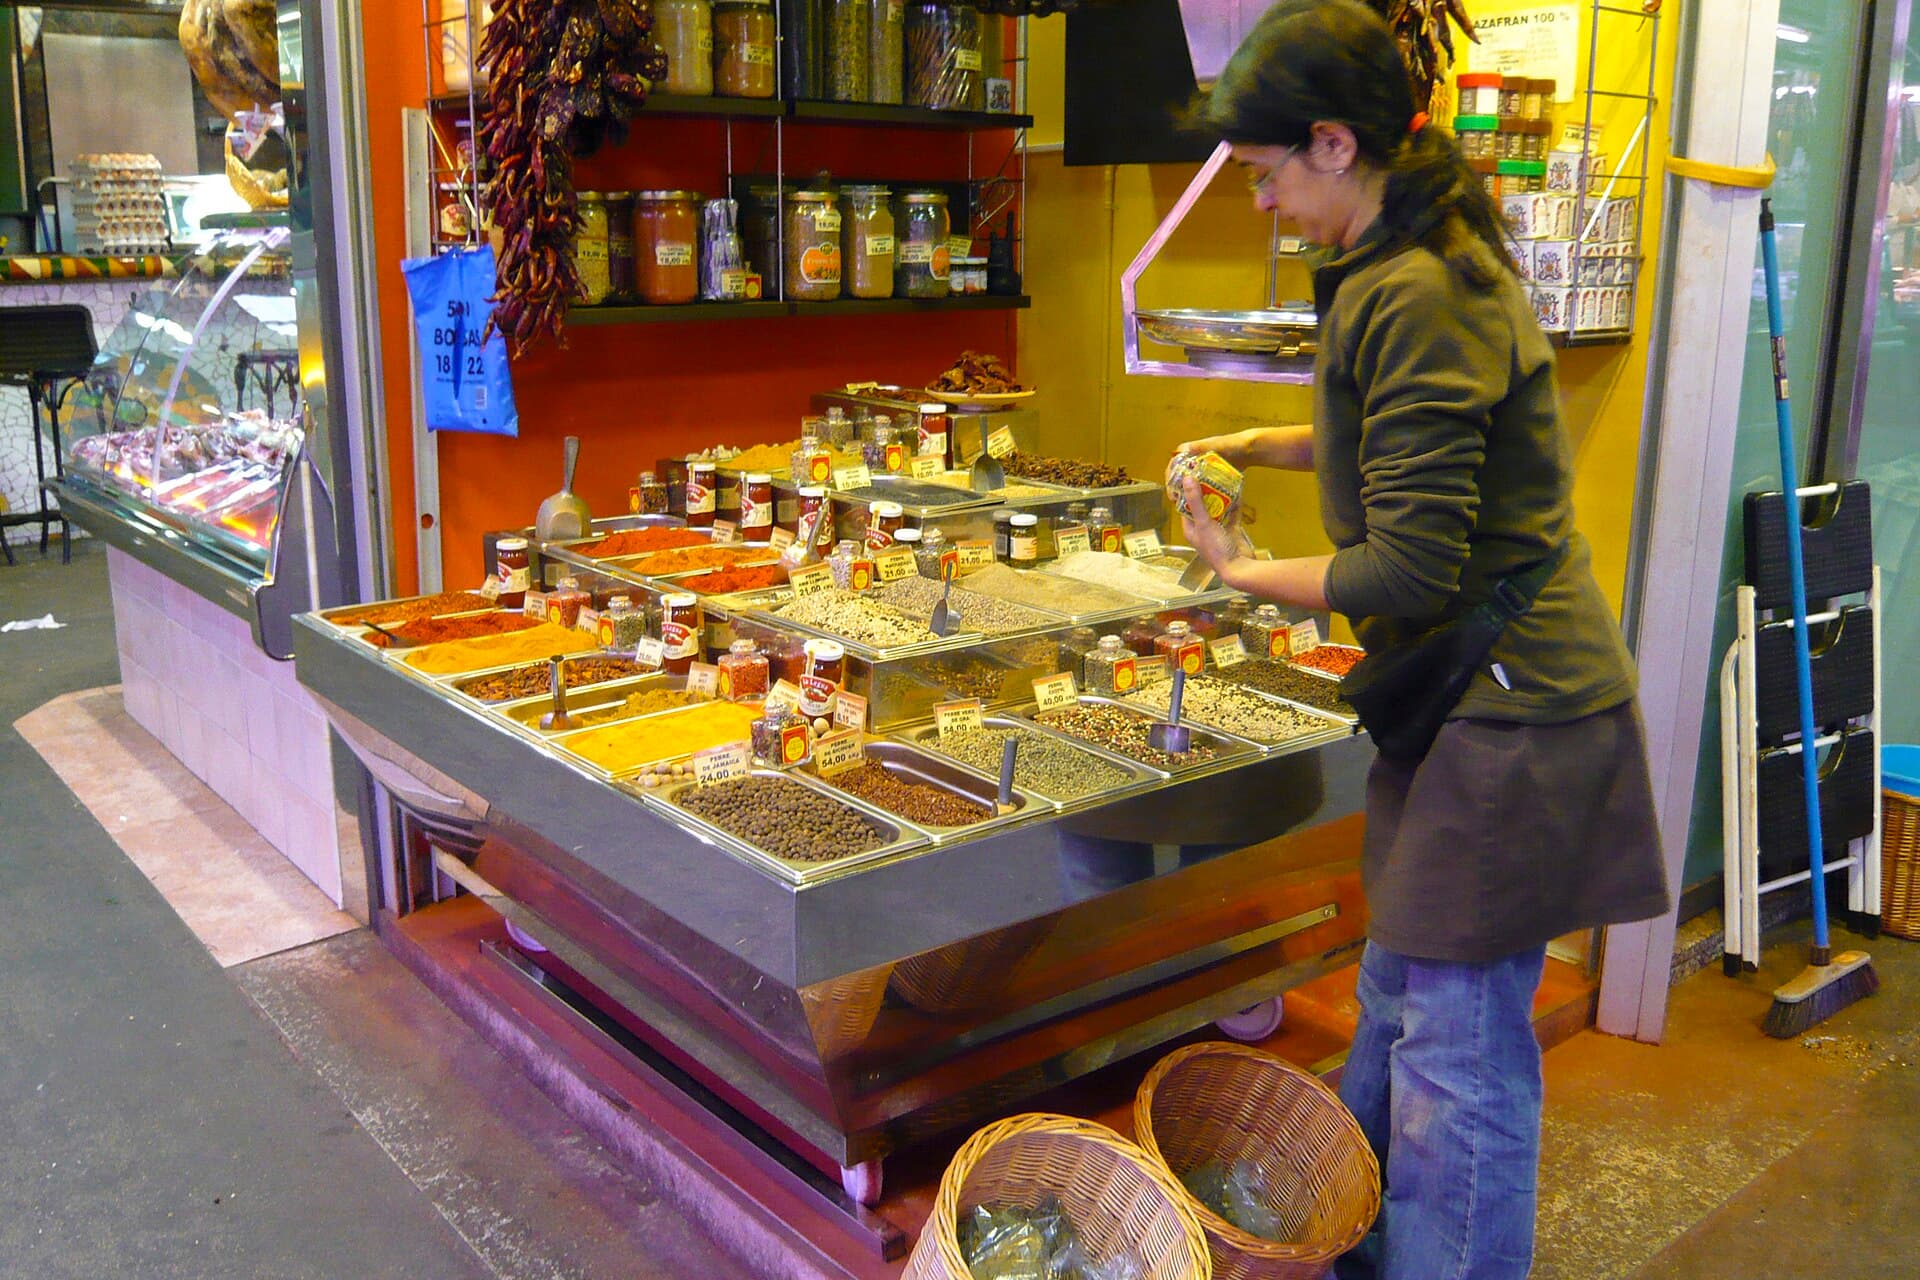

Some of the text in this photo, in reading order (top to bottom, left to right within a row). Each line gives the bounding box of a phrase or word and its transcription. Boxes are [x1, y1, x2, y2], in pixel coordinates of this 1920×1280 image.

[1473, 15, 1528, 29] AZAFRAN
[1533, 12, 1555, 23] 100
[434, 328, 481, 347] BOAS
[436, 355, 484, 375] 18 22
[884, 568, 905, 579] 21,00
[799, 585, 821, 597] 21,00
[1042, 694, 1063, 706] 40,00
[943, 724, 967, 735] 54,00
[830, 738, 848, 748] PEBRE
[710, 752, 730, 763] PEBRE
[821, 754, 846, 768] 54,00
[712, 758, 740, 770] JAMAICA
[699, 769, 729, 785] 24,00
